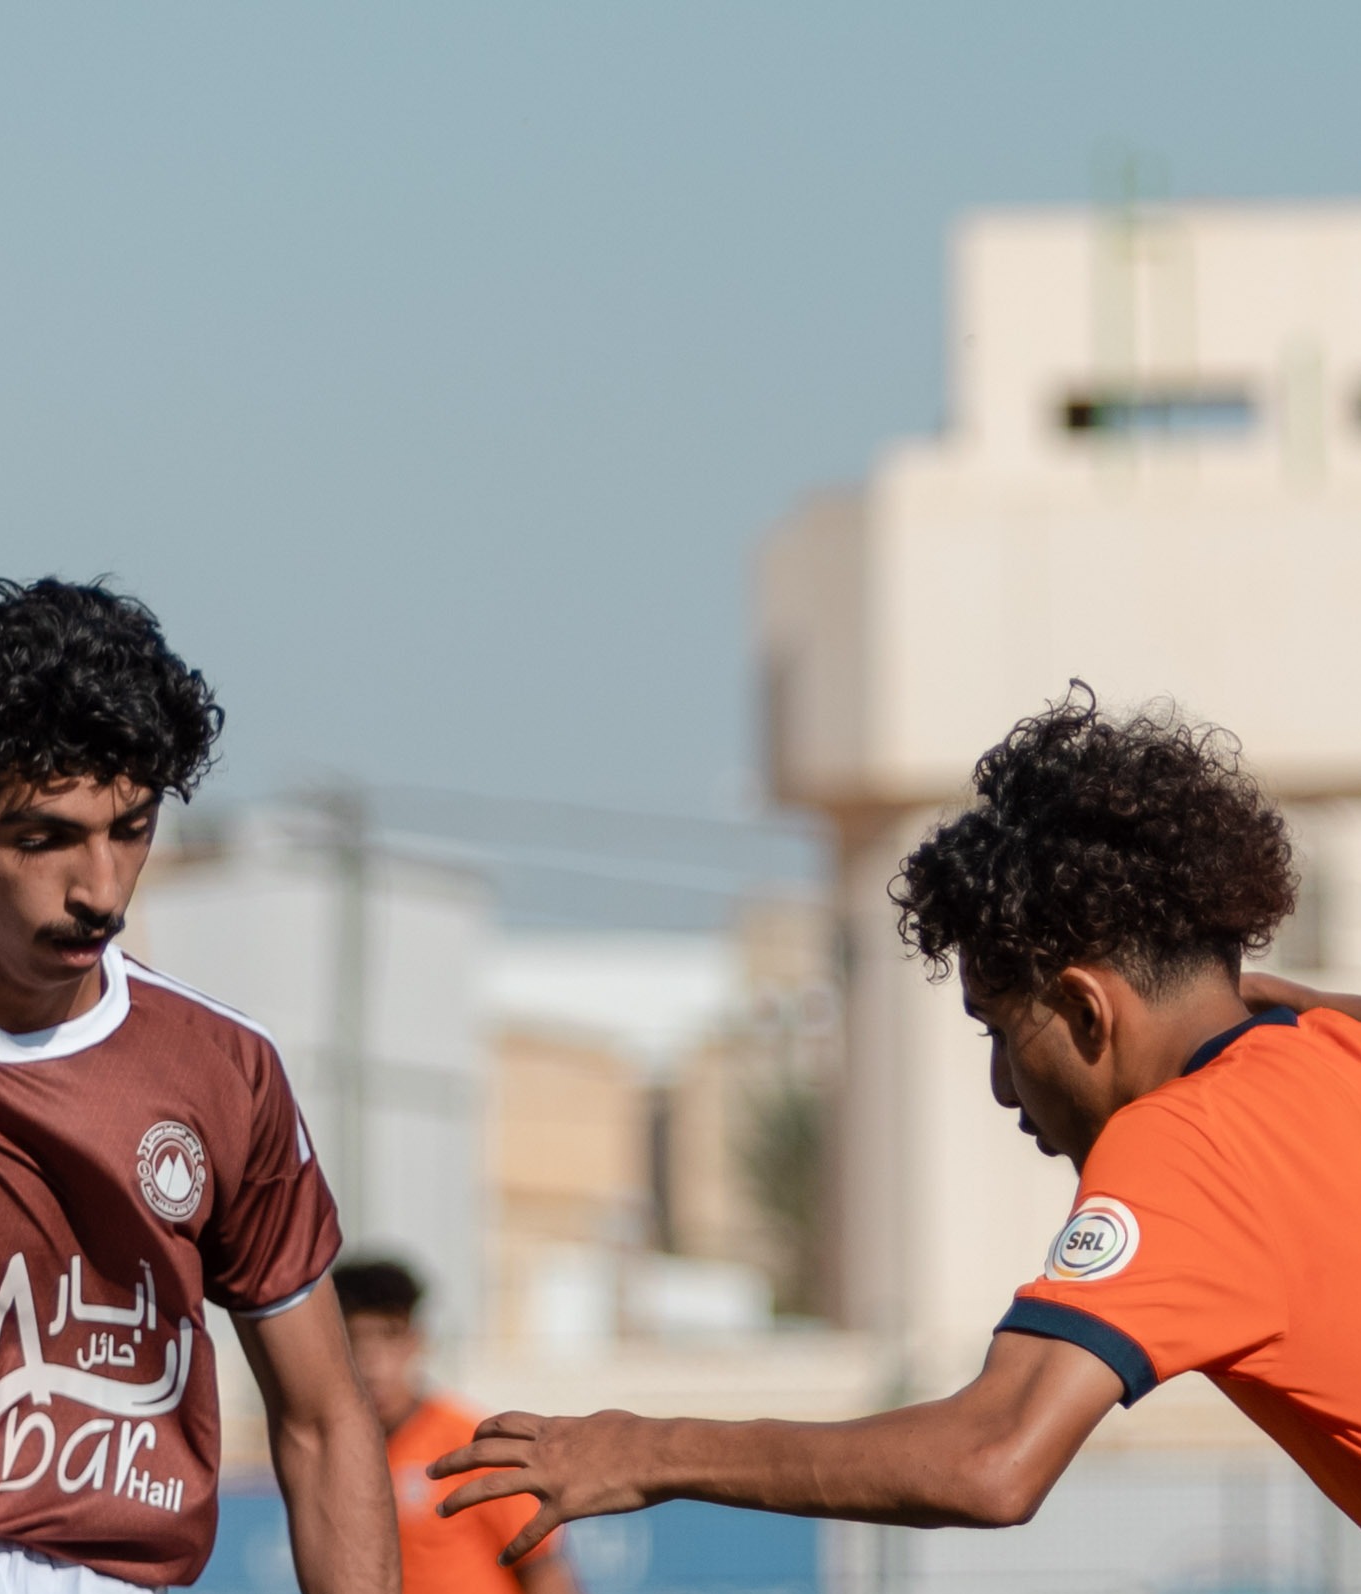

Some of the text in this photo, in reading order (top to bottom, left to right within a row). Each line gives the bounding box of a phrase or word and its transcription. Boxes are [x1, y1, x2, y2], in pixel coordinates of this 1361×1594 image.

[1066, 1231, 1105, 1251] SRL
[76, 1331, 136, 1370] حائل
[127, 1467, 184, 1513] Hail
